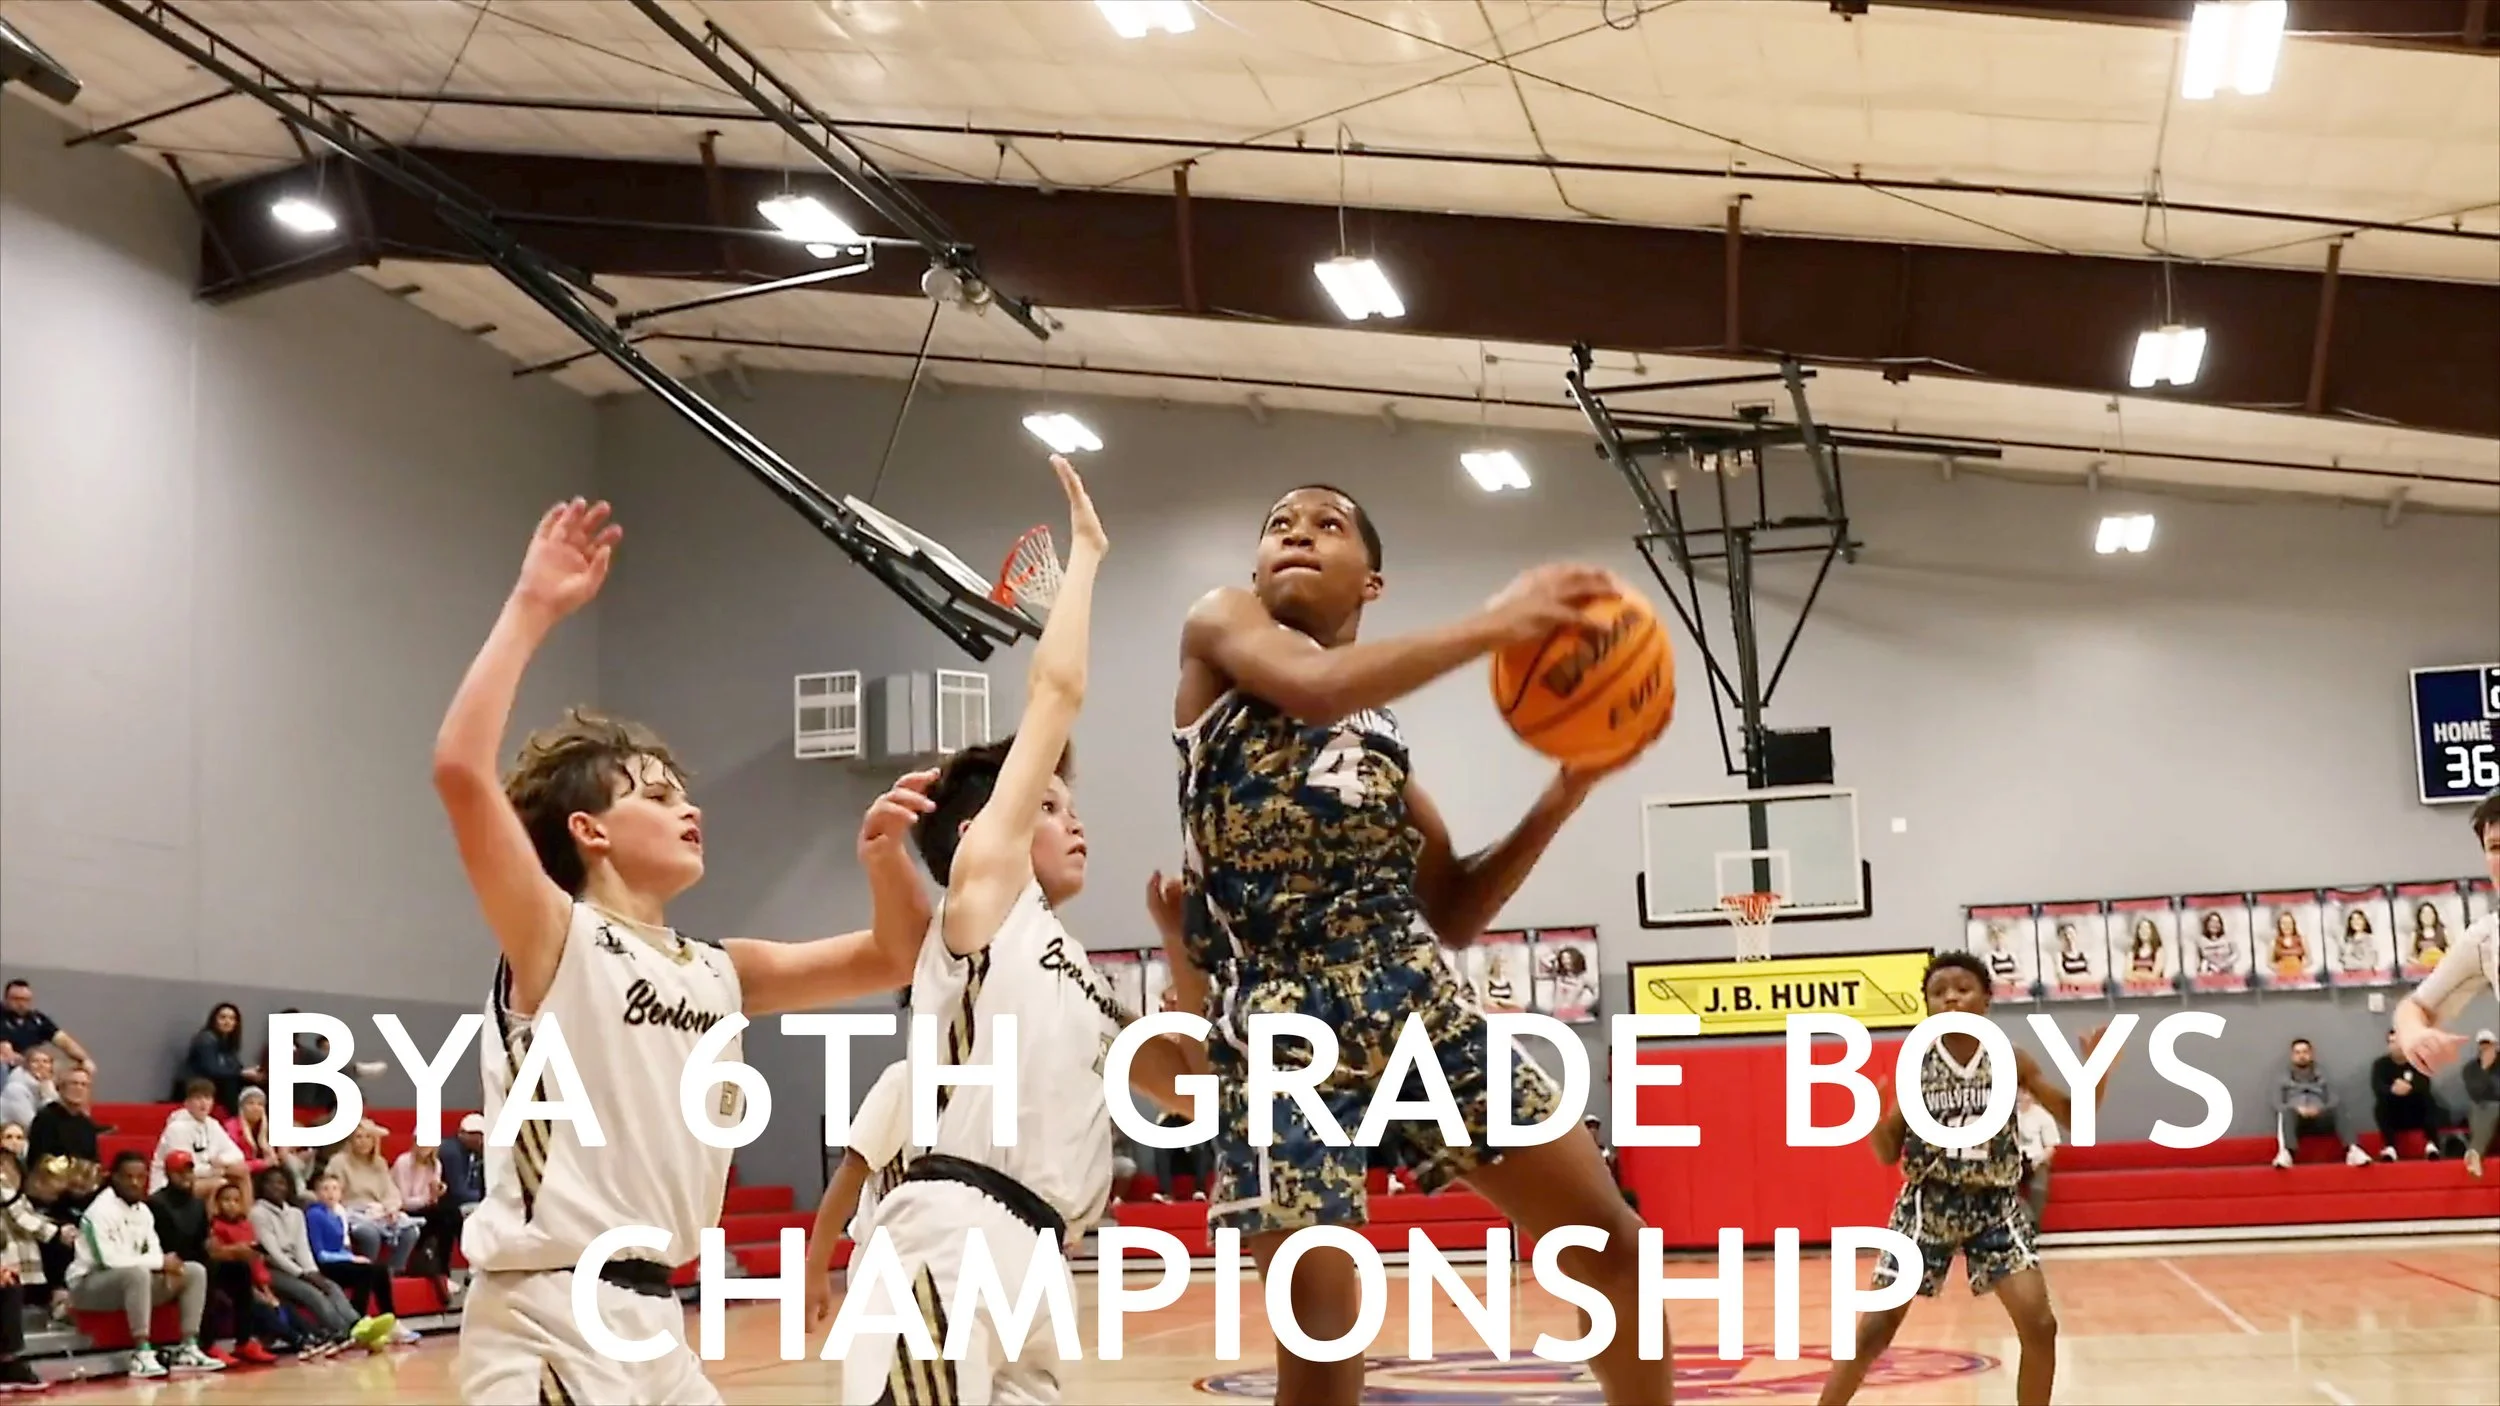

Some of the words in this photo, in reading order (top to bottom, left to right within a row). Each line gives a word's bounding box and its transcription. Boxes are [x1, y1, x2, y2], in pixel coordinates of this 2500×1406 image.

[2433, 720, 2492, 743] HOME
[1306, 729, 1366, 809] 4
[2445, 744, 2500, 788] 36
[1704, 985, 1761, 1013] J.B.
[1771, 980, 1860, 1010] HUNT
